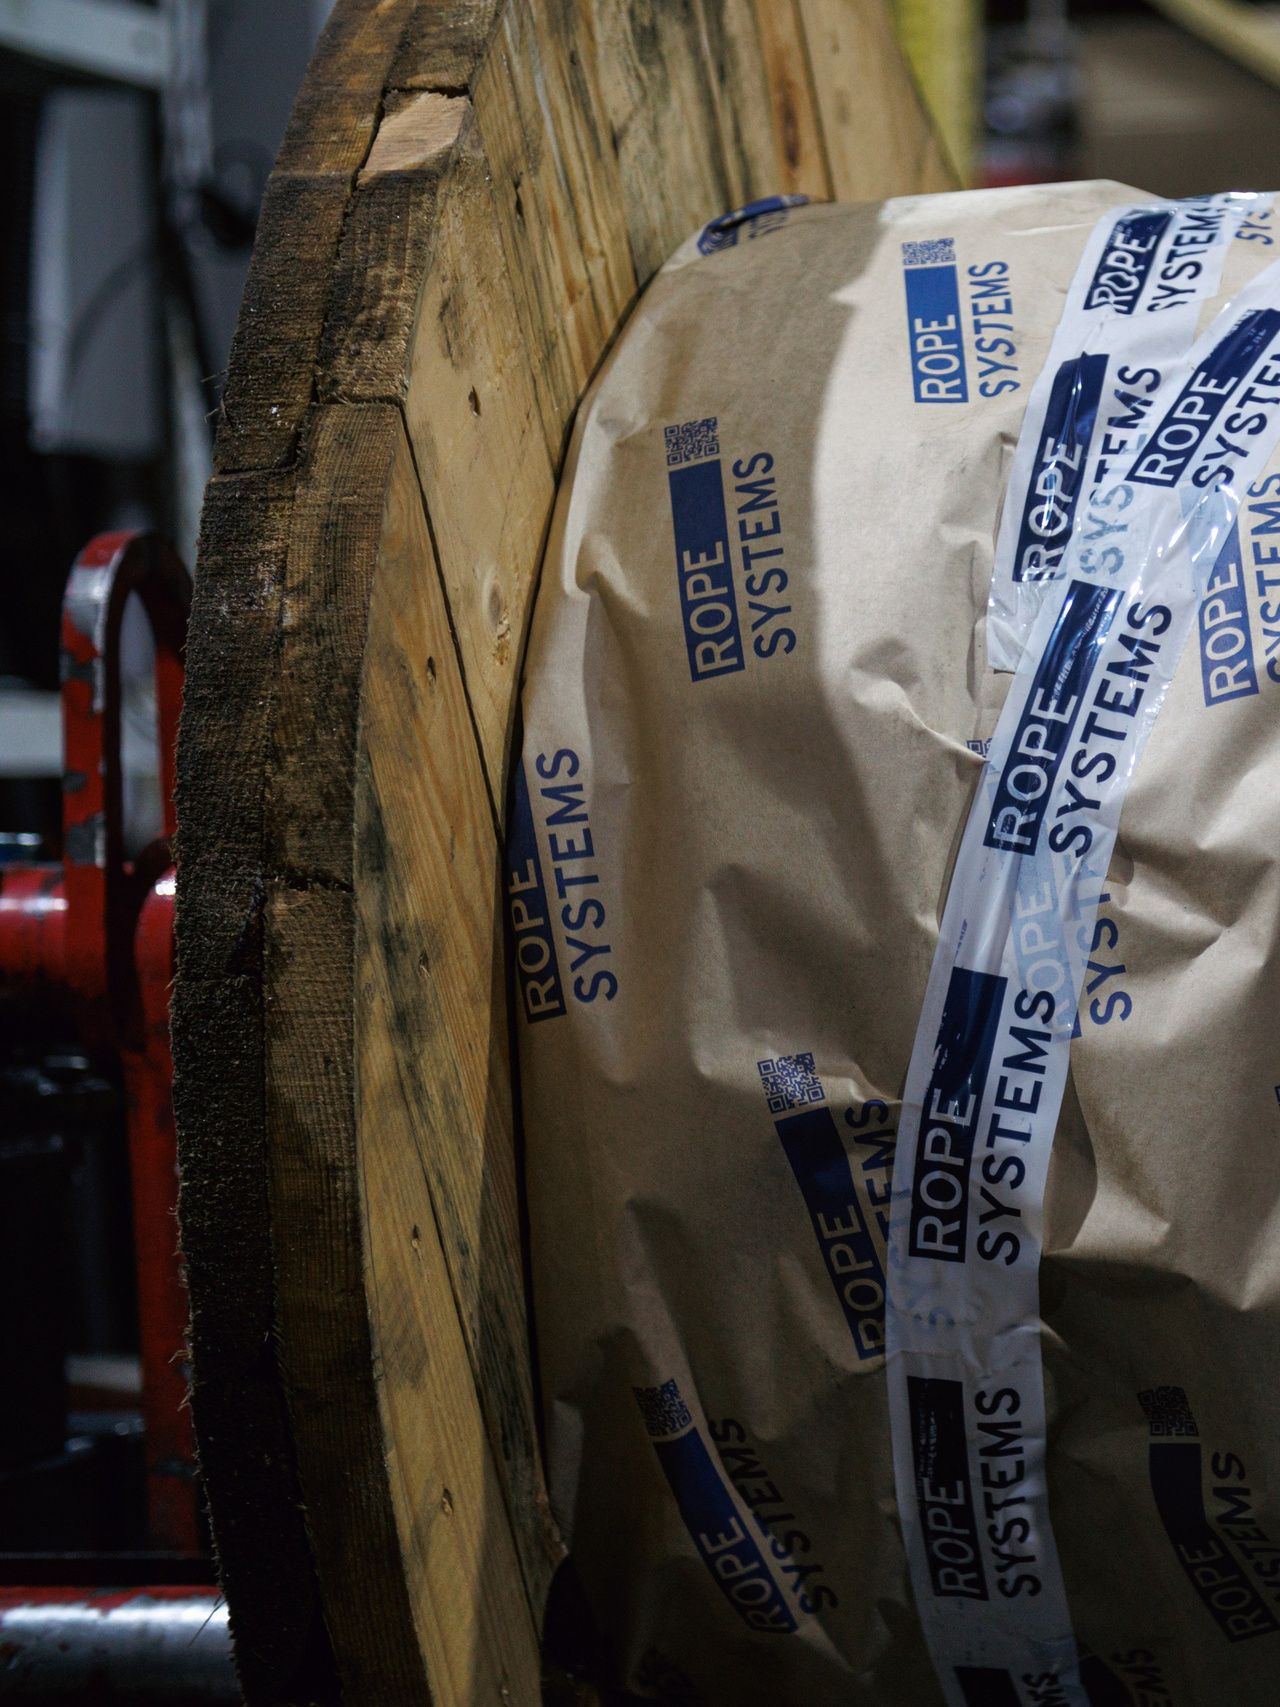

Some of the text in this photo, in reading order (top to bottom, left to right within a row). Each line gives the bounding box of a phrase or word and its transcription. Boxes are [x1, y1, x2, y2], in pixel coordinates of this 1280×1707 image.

[968, 261, 1021, 398] SYSTEMS
[1090, 234, 1158, 315] ROPE
[914, 314, 962, 400] ROPE
[1135, 371, 1238, 482] ROPE
[732, 452, 797, 659] SYSTEMS
[1020, 436, 1083, 582] ROPE
[683, 540, 738, 674] ROPE
[1205, 562, 1252, 698] ROPE
[993, 686, 1079, 847] ROPE
[1048, 601, 1172, 859] SYSTEMS
[508, 858, 561, 1016] ROPE
[535, 748, 618, 1004] SYSTEMS
[916, 1087, 978, 1255] ROPE
[977, 989, 1056, 1266] SYSTEMS
[708, 1417, 838, 1614] SYSTEMS
[923, 1476, 981, 1595] ROPE
[975, 1387, 1043, 1598] SYSTEMS
[699, 1516, 790, 1629] ROPE
[1178, 1540, 1271, 1636] ROPE
